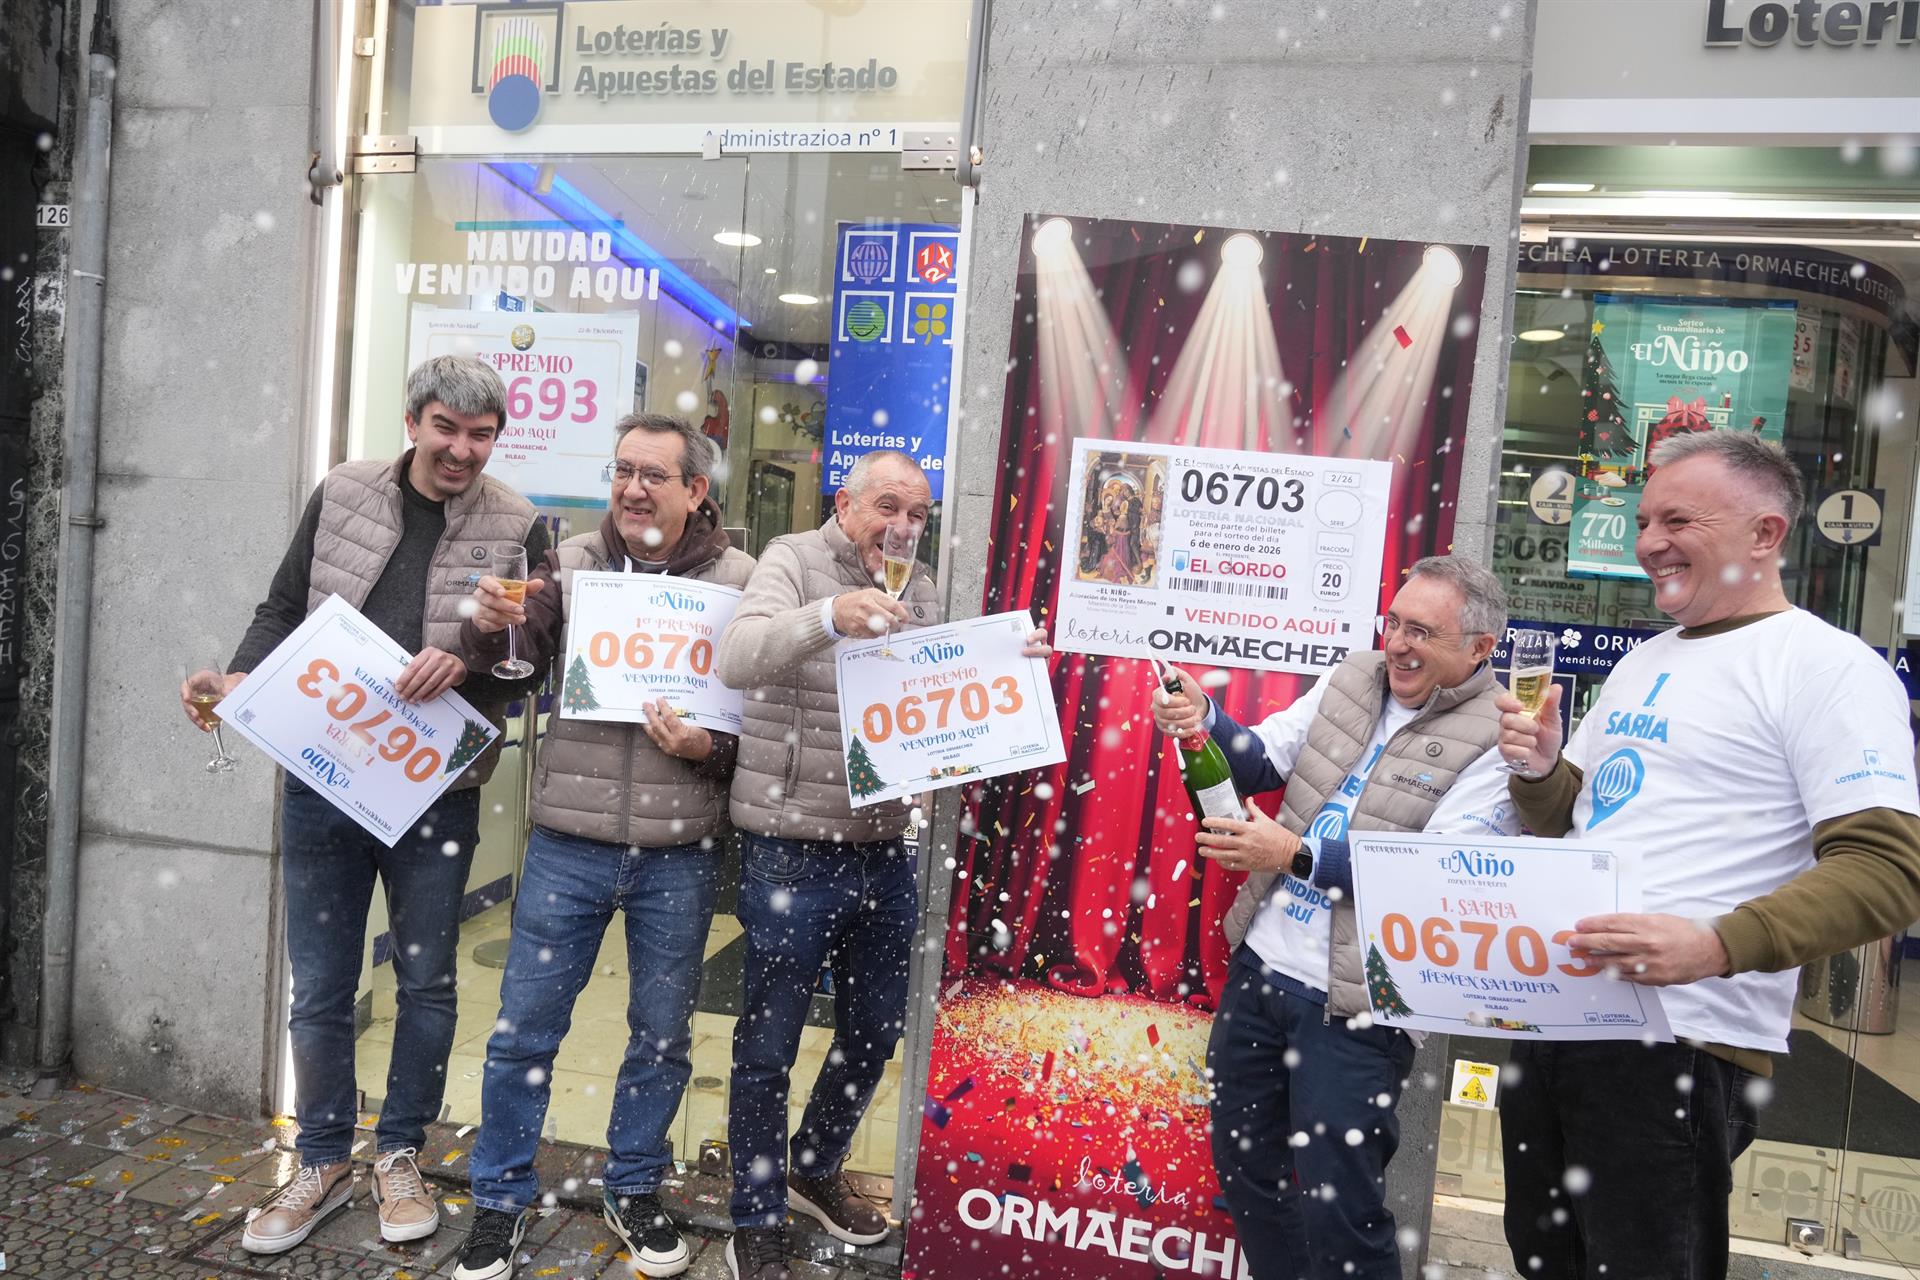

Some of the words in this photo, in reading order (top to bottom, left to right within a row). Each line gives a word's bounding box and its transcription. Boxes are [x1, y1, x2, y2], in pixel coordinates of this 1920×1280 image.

[574, 21, 702, 53] Loterías
[709, 27, 729, 56] y
[573, 64, 717, 95] Apuestas
[726, 60, 775, 91] del
[784, 59, 898, 91] Estado
[702, 128, 851, 147] dministrazioa
[889, 128, 897, 146] 1
[36, 207, 69, 225] 126
[467, 231, 612, 262] NAVIDAD
[1609, 247, 1721, 268] LOTERIA
[1736, 253, 1850, 287] ORMAECHEA
[395, 263, 555, 298] VENDIDO
[569, 266, 660, 303] AQUI
[493, 352, 573, 374] PREMIO
[1630, 343, 1651, 361] El
[1651, 335, 1749, 374] Niño
[511, 443, 548, 451] ORMAECHEA
[832, 430, 906, 449] Loterías
[911, 436, 922, 453] y
[1331, 474, 1353, 484] 2/26
[1181, 469, 1305, 513] 06703
[1841, 495, 1854, 519] 1
[1189, 520, 1219, 529] Décima
[1221, 523, 1243, 533] parte
[1245, 524, 1258, 532] del
[1260, 526, 1286, 535] billete
[1194, 531, 1212, 539] para
[1224, 533, 1249, 541] sorteo
[1250, 534, 1264, 542] del
[1582, 512, 1627, 540] 770
[1190, 540, 1196, 548] 6
[1198, 540, 1211, 549] de
[1213, 543, 1241, 551] enero
[1243, 543, 1256, 553] de
[1258, 546, 1281, 555] 2026
[1578, 538, 1624, 551] Millones
[1190, 558, 1213, 574] EL
[1218, 560, 1287, 579] GORDO
[1323, 563, 1343, 571] PRECIO
[1321, 573, 1342, 588] 20
[1531, 579, 1585, 591] NAVIDAD
[657, 591, 706, 612] Niño
[655, 617, 713, 637] PREMIO
[1184, 607, 1278, 631] VENDIDO
[1283, 618, 1336, 635] AQUÍ
[909, 652, 920, 664] El
[919, 642, 965, 665] Niño
[1150, 629, 1349, 666] ORMAECHEA
[1558, 655, 1613, 667] vendidos
[622, 673, 680, 685] VENDIDO
[919, 667, 978, 689] PREMIO
[862, 676, 1023, 743] 06703
[297, 659, 442, 783] 06703
[1605, 710, 1669, 743] SARIA
[326, 723, 364, 758] SRIA
[899, 730, 956, 752] VENDIDO
[956, 724, 990, 745] AQUÍ
[301, 747, 346, 787] Niño
[943, 753, 960, 761] BILBAO
[1835, 769, 1872, 785] LOTERÍA
[1873, 769, 1906, 782] NACIONAL
[1462, 813, 1490, 826] LOTERÍA
[1438, 857, 1452, 870] El
[1451, 850, 1515, 877] Niño
[1283, 901, 1316, 925] QUÍ
[1458, 898, 1518, 920] SARIA
[1418, 968, 1482, 991] HEMEN
[1480, 977, 1560, 995] SALDUTA
[1484, 1003, 1509, 1011] BILBAO
[1488, 995, 1528, 1004] ORMAECHEA
[1601, 1017, 1640, 1025] NACIONAL
